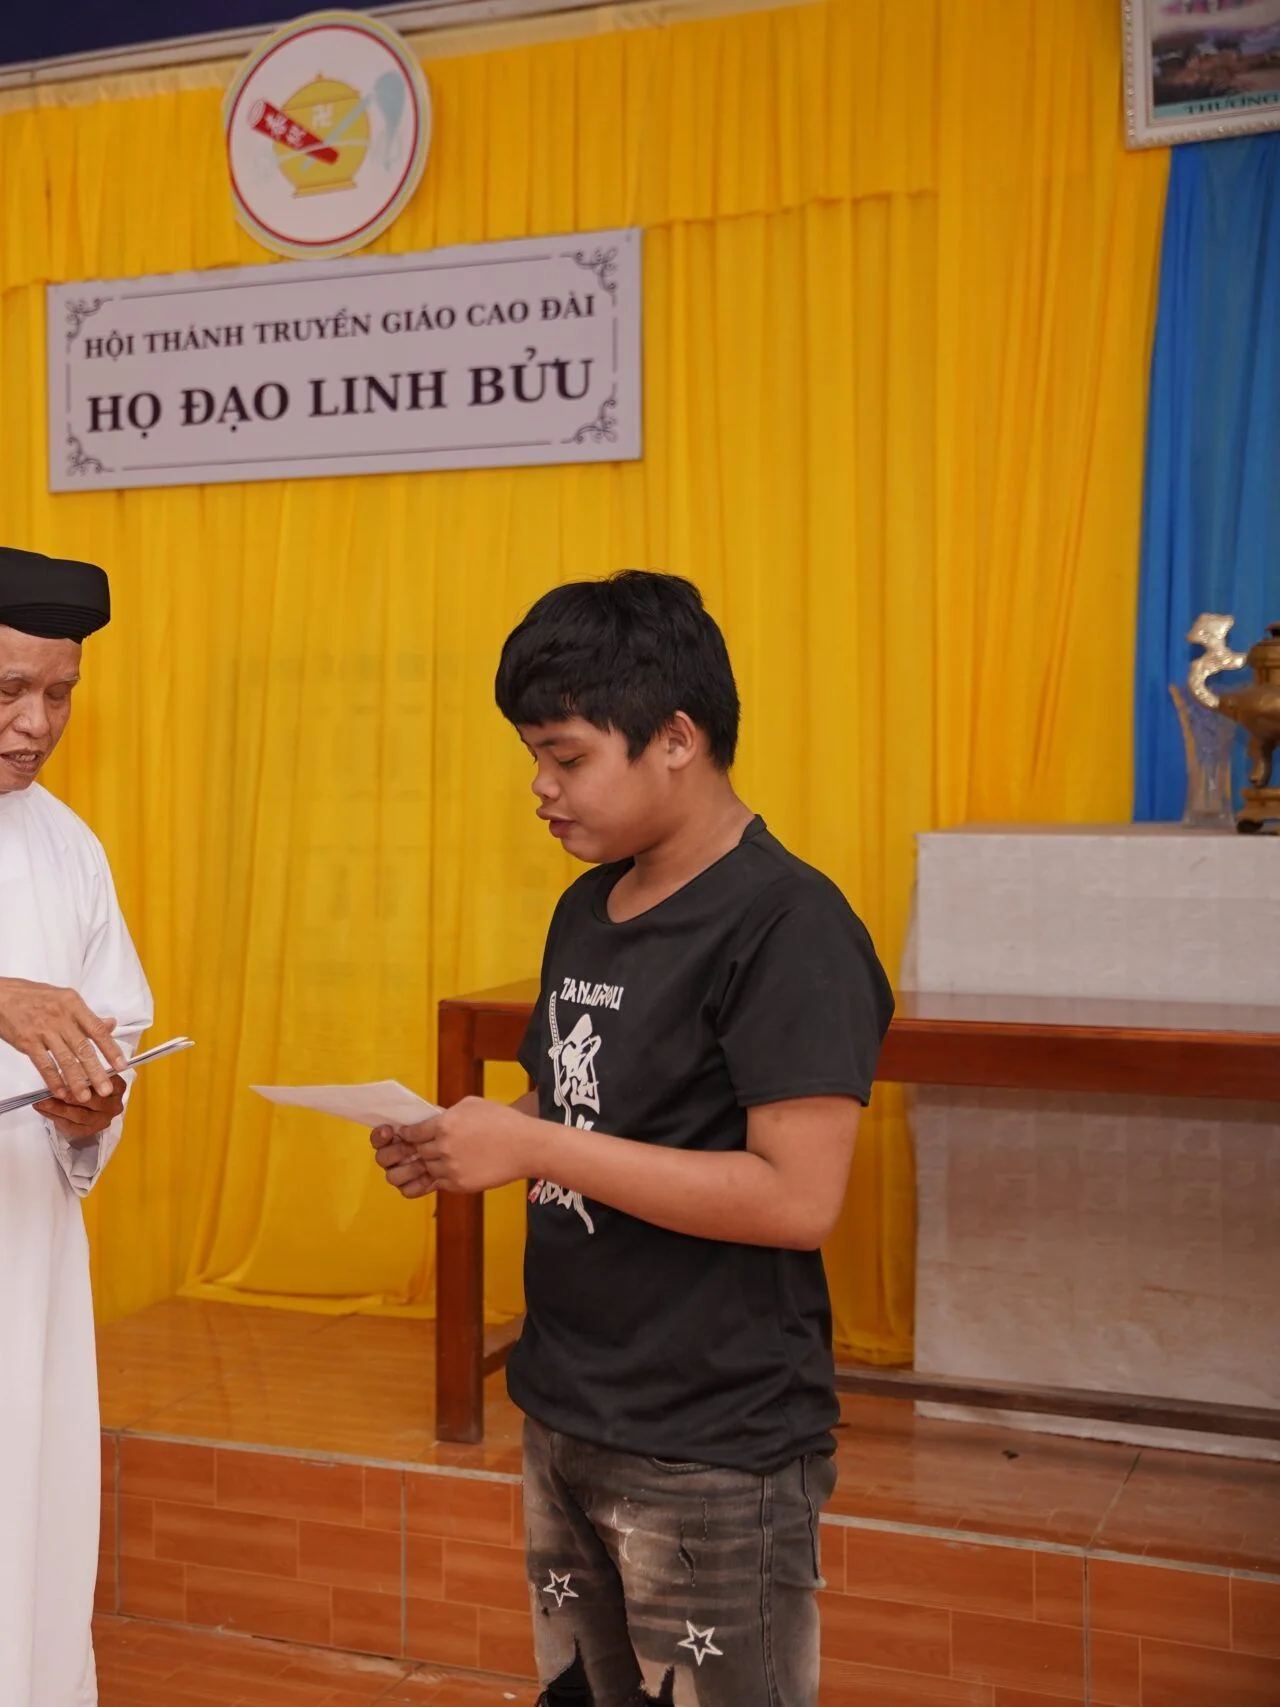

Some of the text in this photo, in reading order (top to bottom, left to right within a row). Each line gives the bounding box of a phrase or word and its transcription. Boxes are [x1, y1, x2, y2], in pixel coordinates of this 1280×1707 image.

[84, 330, 136, 362] HỘI
[142, 325, 245, 354] THÁNH
[381, 304, 456, 334] GIÁO
[465, 299, 529, 328] CAO
[539, 290, 596, 321] ĐÀI
[86, 345, 594, 440] HỌ ĐẠO LINH BỬU
